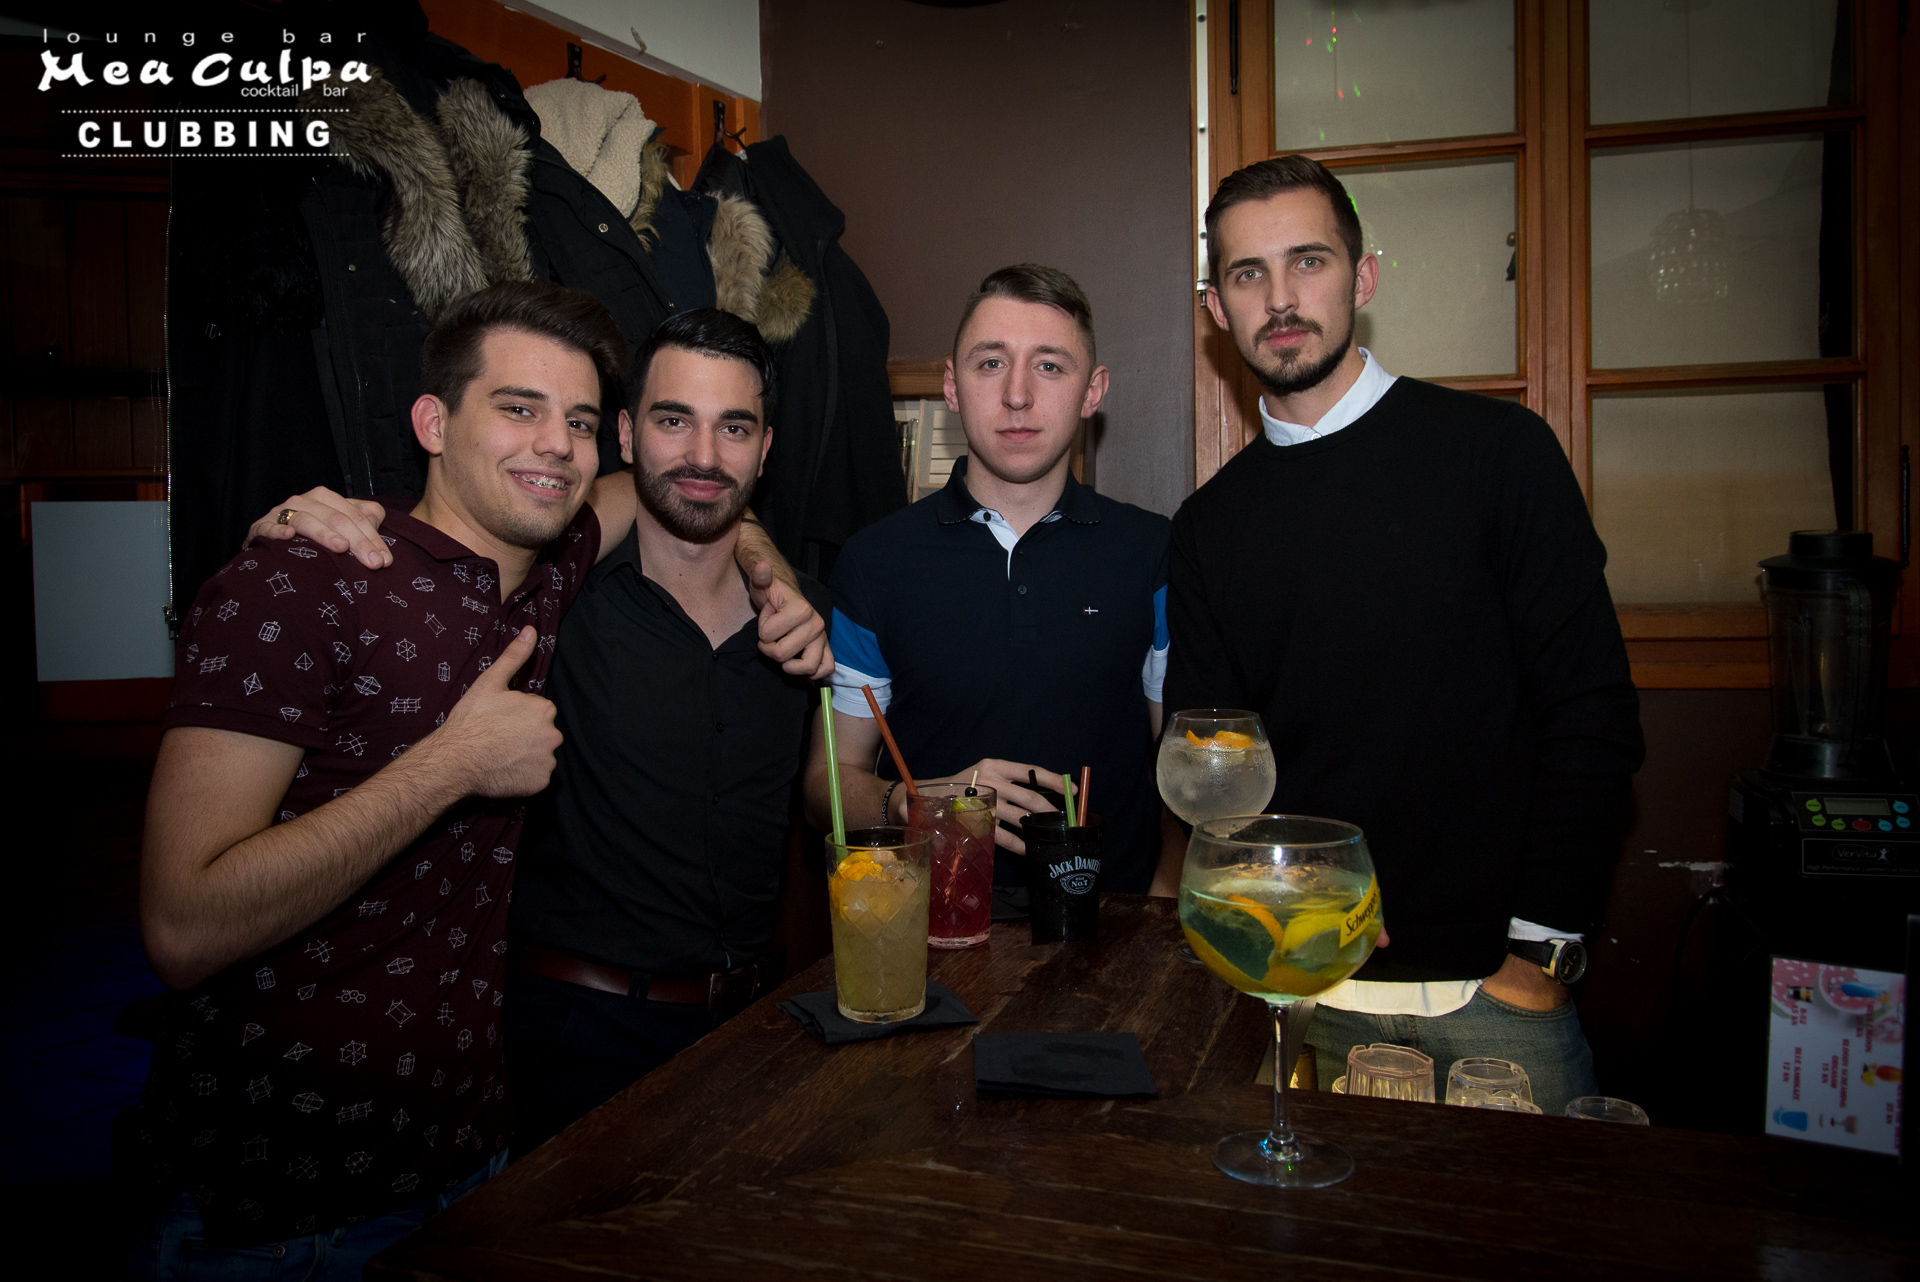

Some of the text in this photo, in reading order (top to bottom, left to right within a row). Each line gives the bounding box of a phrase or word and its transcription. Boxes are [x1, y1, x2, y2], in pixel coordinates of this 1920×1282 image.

[1048, 860, 1074, 878] JACK
[1792, 1067, 1801, 1101] KAMIKAZE
[1840, 1039, 1850, 1108] BLOODY SCREAMING
